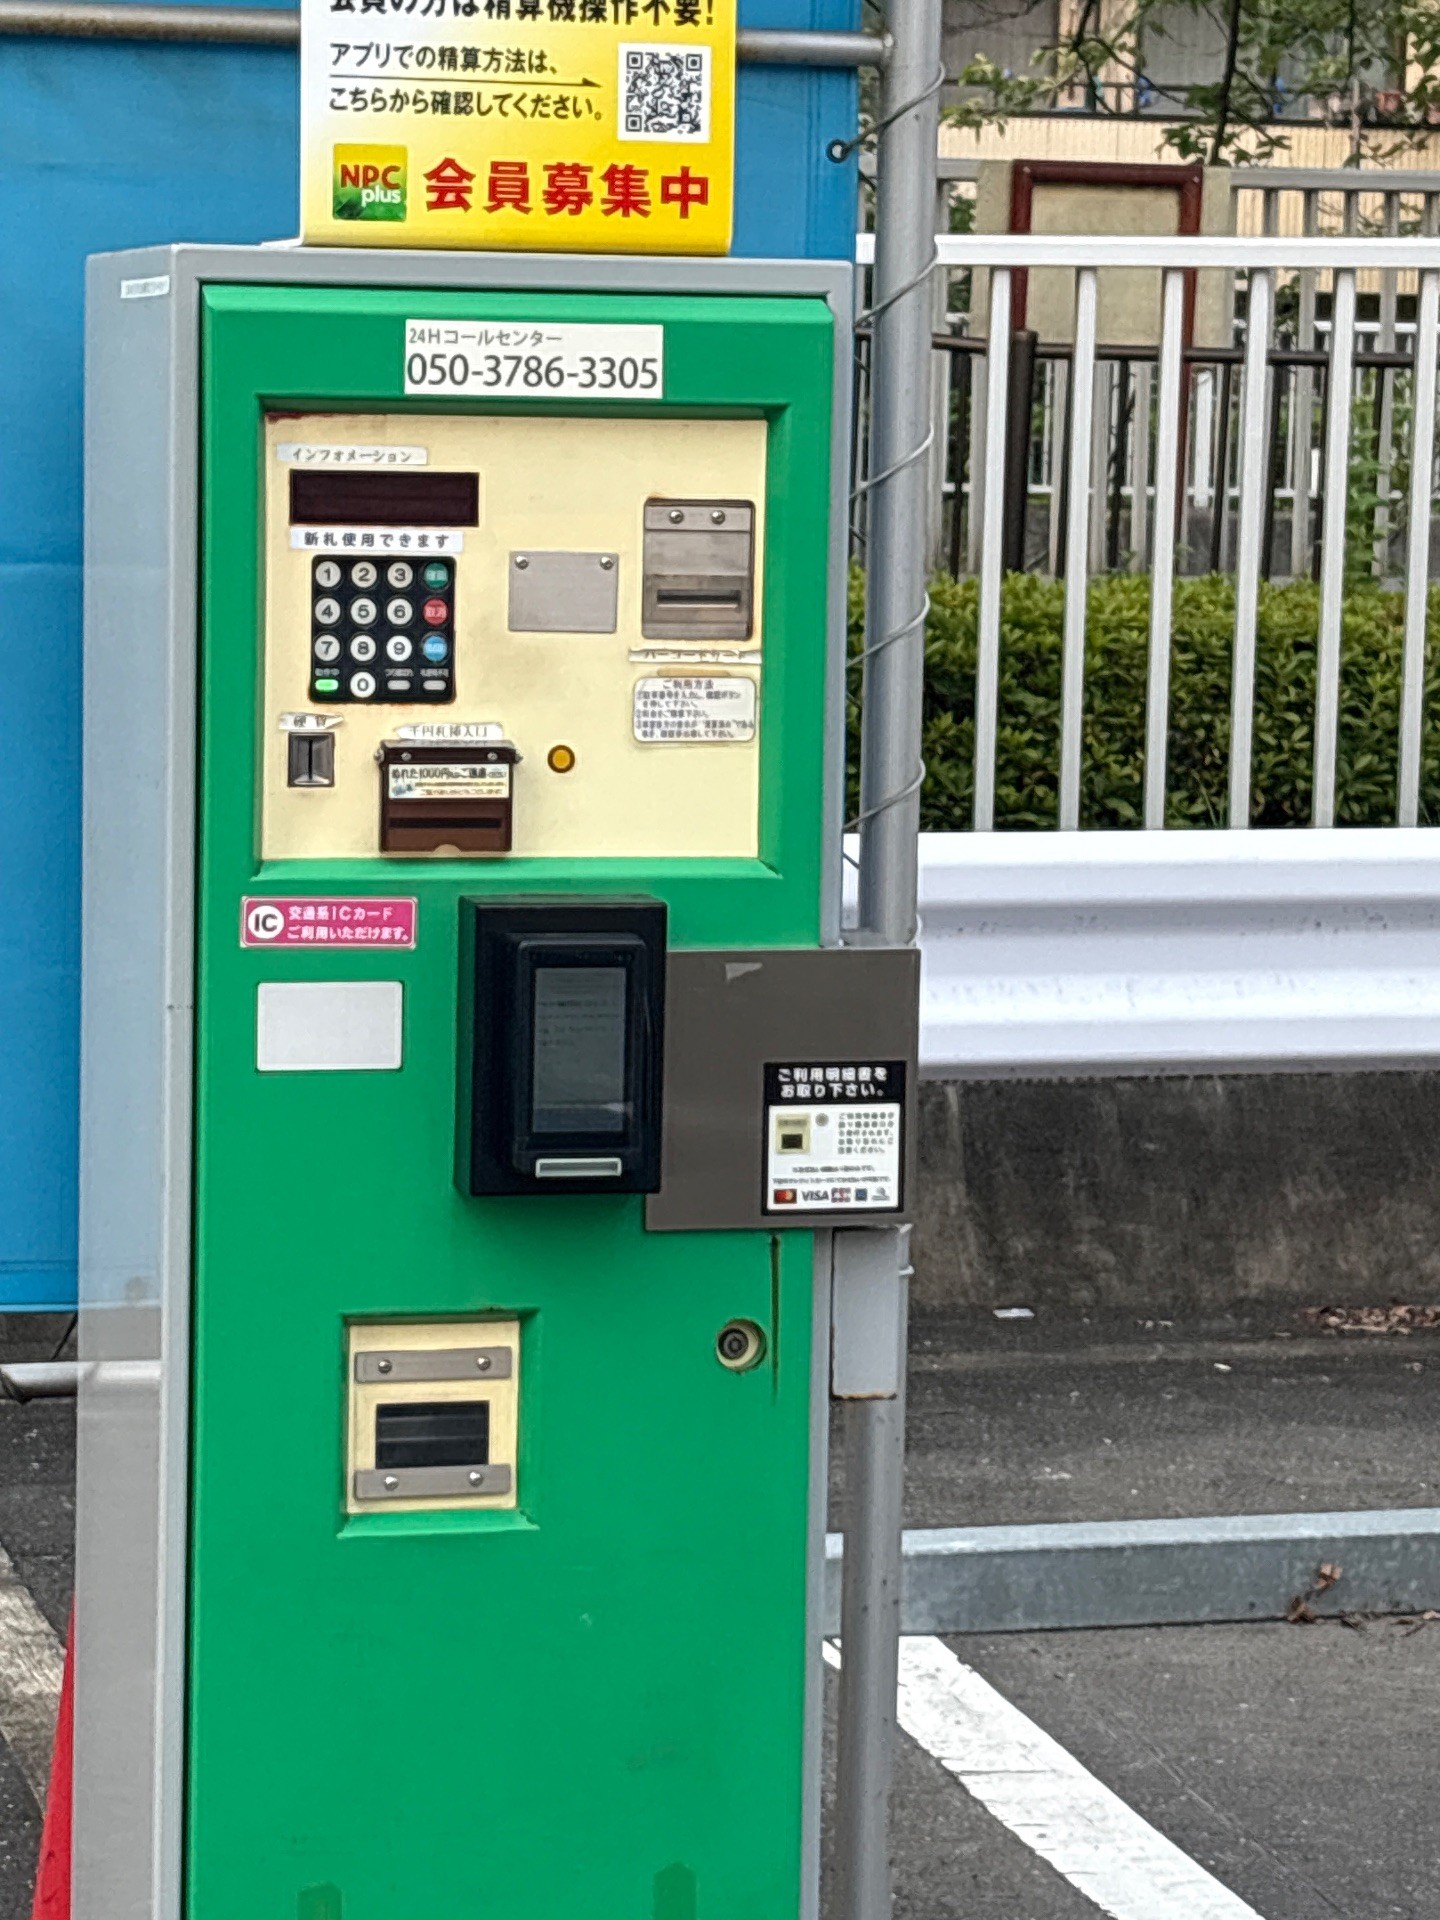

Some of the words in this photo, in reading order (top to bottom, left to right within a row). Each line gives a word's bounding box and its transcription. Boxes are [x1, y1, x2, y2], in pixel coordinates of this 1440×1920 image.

[329, 42, 558, 74] アプリでの精算方法は、
[329, 87, 602, 120] こちらから確認してください。
[340, 164, 400, 190] NPC
[423, 157, 709, 219] 会員募集中
[361, 186, 401, 208] plus
[409, 328, 562, 347] 24Hコールセンター
[407, 353, 658, 389] 050-3786-3305
[304, 532, 449, 548] 新札使用できます
[324, 568, 331, 582] 1
[358, 567, 371, 582] 2
[394, 567, 406, 582] 3
[321, 604, 333, 618] 4
[357, 604, 370, 619] 5
[394, 605, 406, 619] 6
[321, 641, 333, 655] 7
[357, 641, 370, 655] 8
[393, 641, 406, 655] 9
[357, 678, 369, 692] 0
[288, 906, 393, 921] 交通系ICカード
[254, 913, 278, 932] IC
[287, 925, 409, 941] ご利用いただけます。
[802, 1190, 829, 1202] VISA
